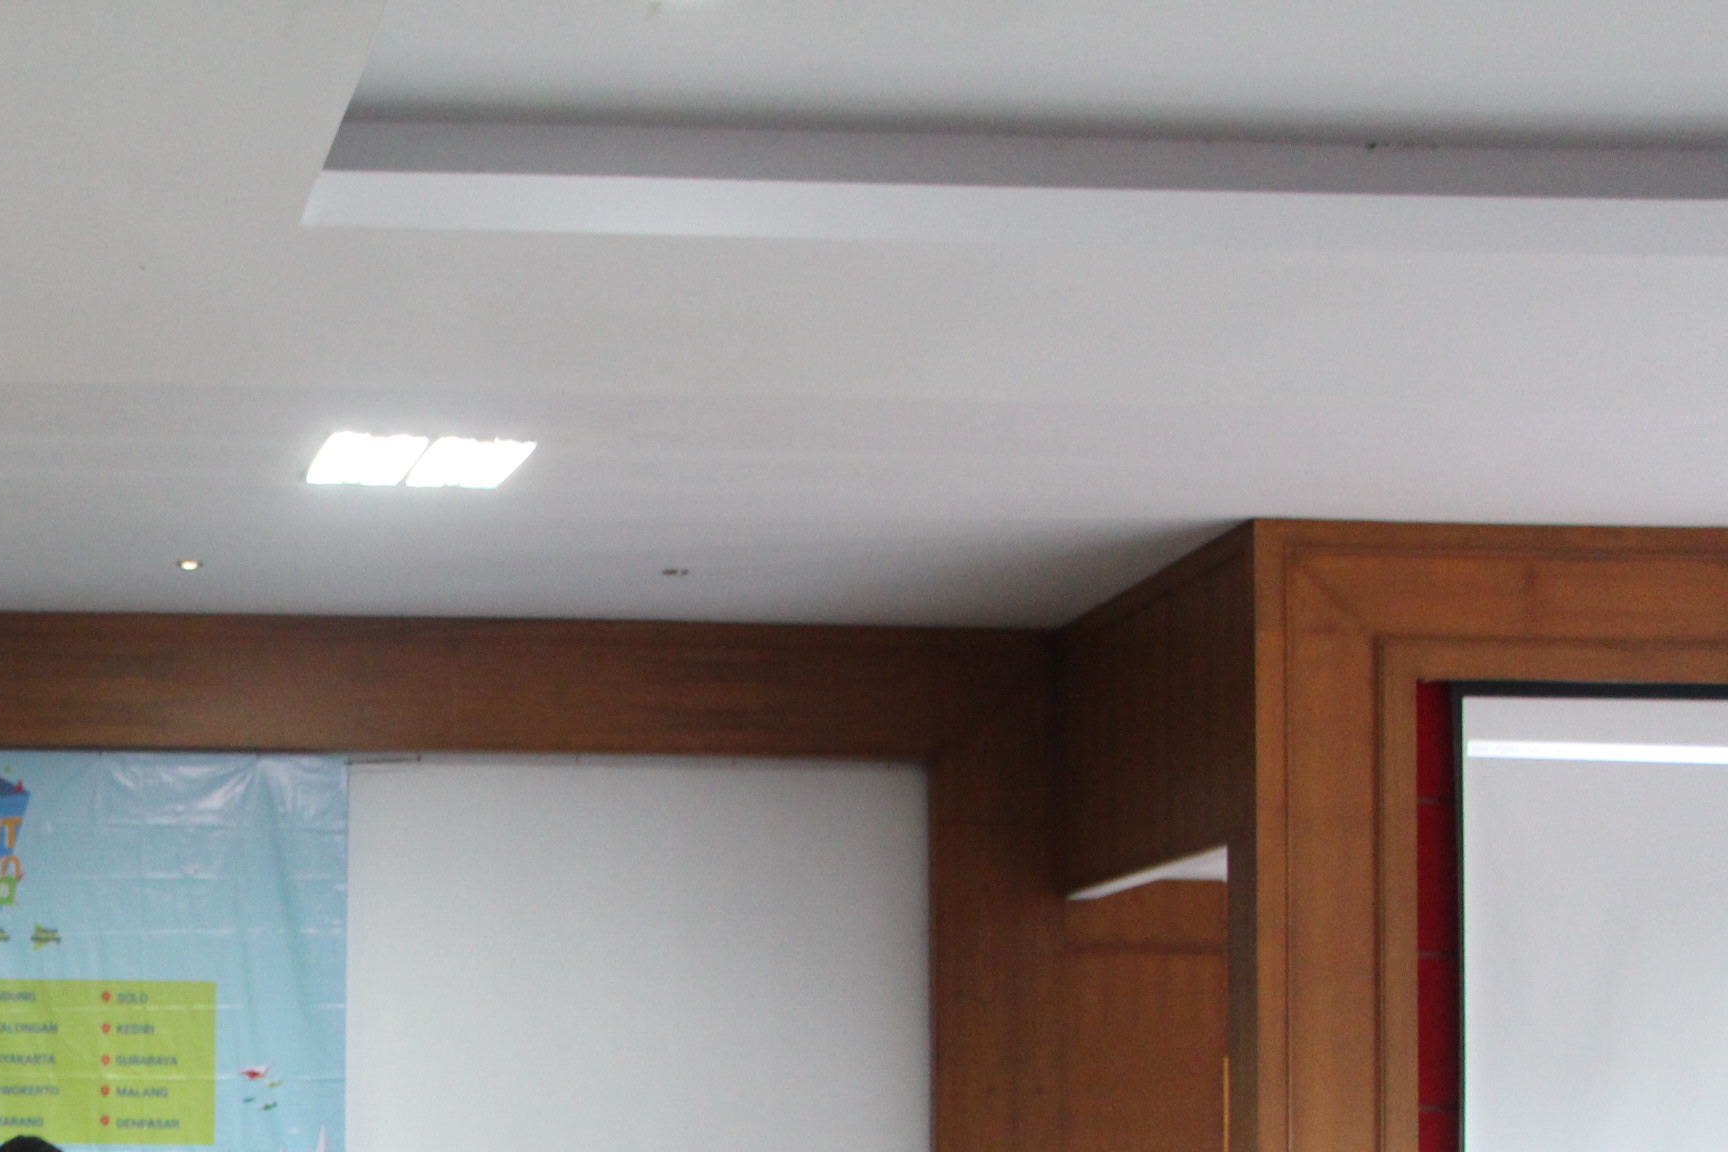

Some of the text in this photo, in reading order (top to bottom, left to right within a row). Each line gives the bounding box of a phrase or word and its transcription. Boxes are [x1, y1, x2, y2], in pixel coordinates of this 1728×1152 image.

[117, 993, 148, 1004] SOLO
[116, 1024, 154, 1035] KEDIRI
[116, 1055, 178, 1066] SURABAYA
[117, 1087, 168, 1098] MALANG
[116, 1118, 180, 1130] DENPASAR
